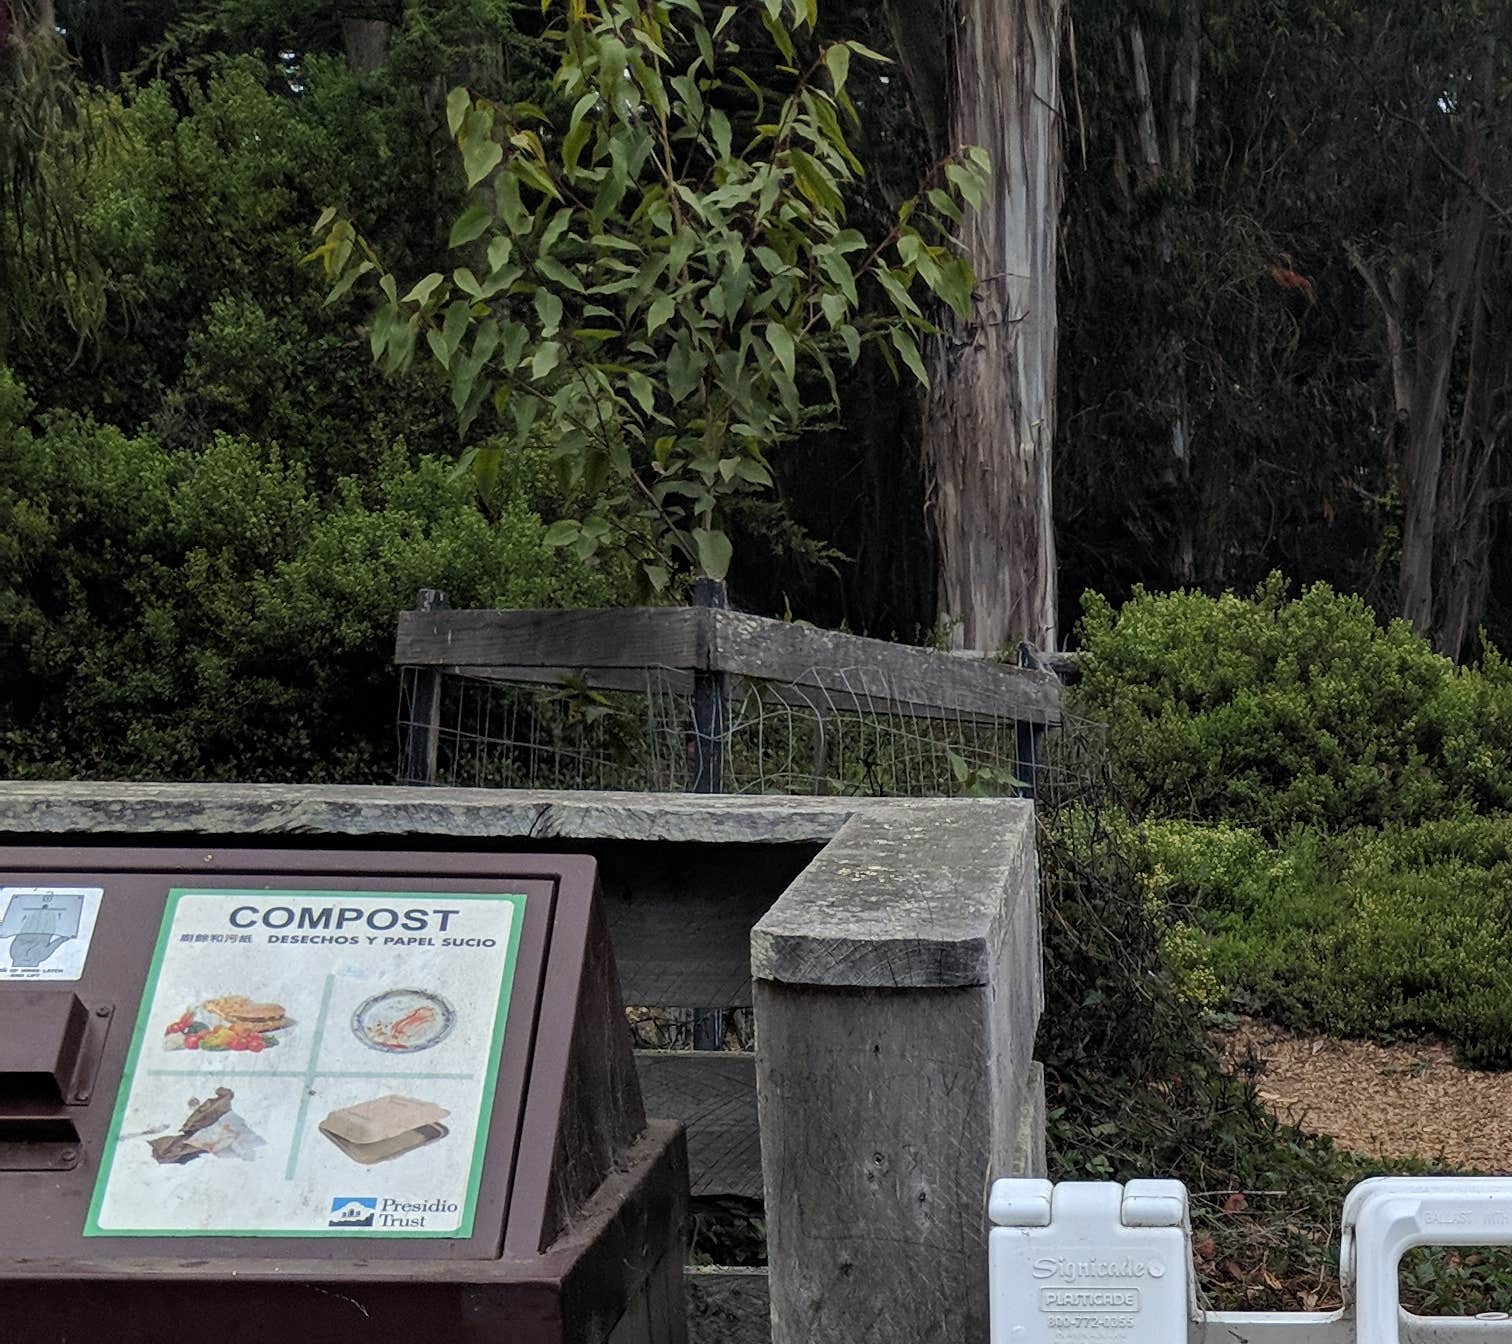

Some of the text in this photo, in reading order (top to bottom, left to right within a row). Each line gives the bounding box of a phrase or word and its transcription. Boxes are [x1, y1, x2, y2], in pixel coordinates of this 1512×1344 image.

[228, 905, 460, 932] COMPOST
[267, 934, 496, 948] DESECHOS Y PAPEL SUCIO
[381, 1198, 458, 1213] Presidio
[379, 1213, 427, 1228] Trust
[1031, 1255, 1146, 1284] Signicade
[1045, 1292, 1135, 1307] PLASTICADE
